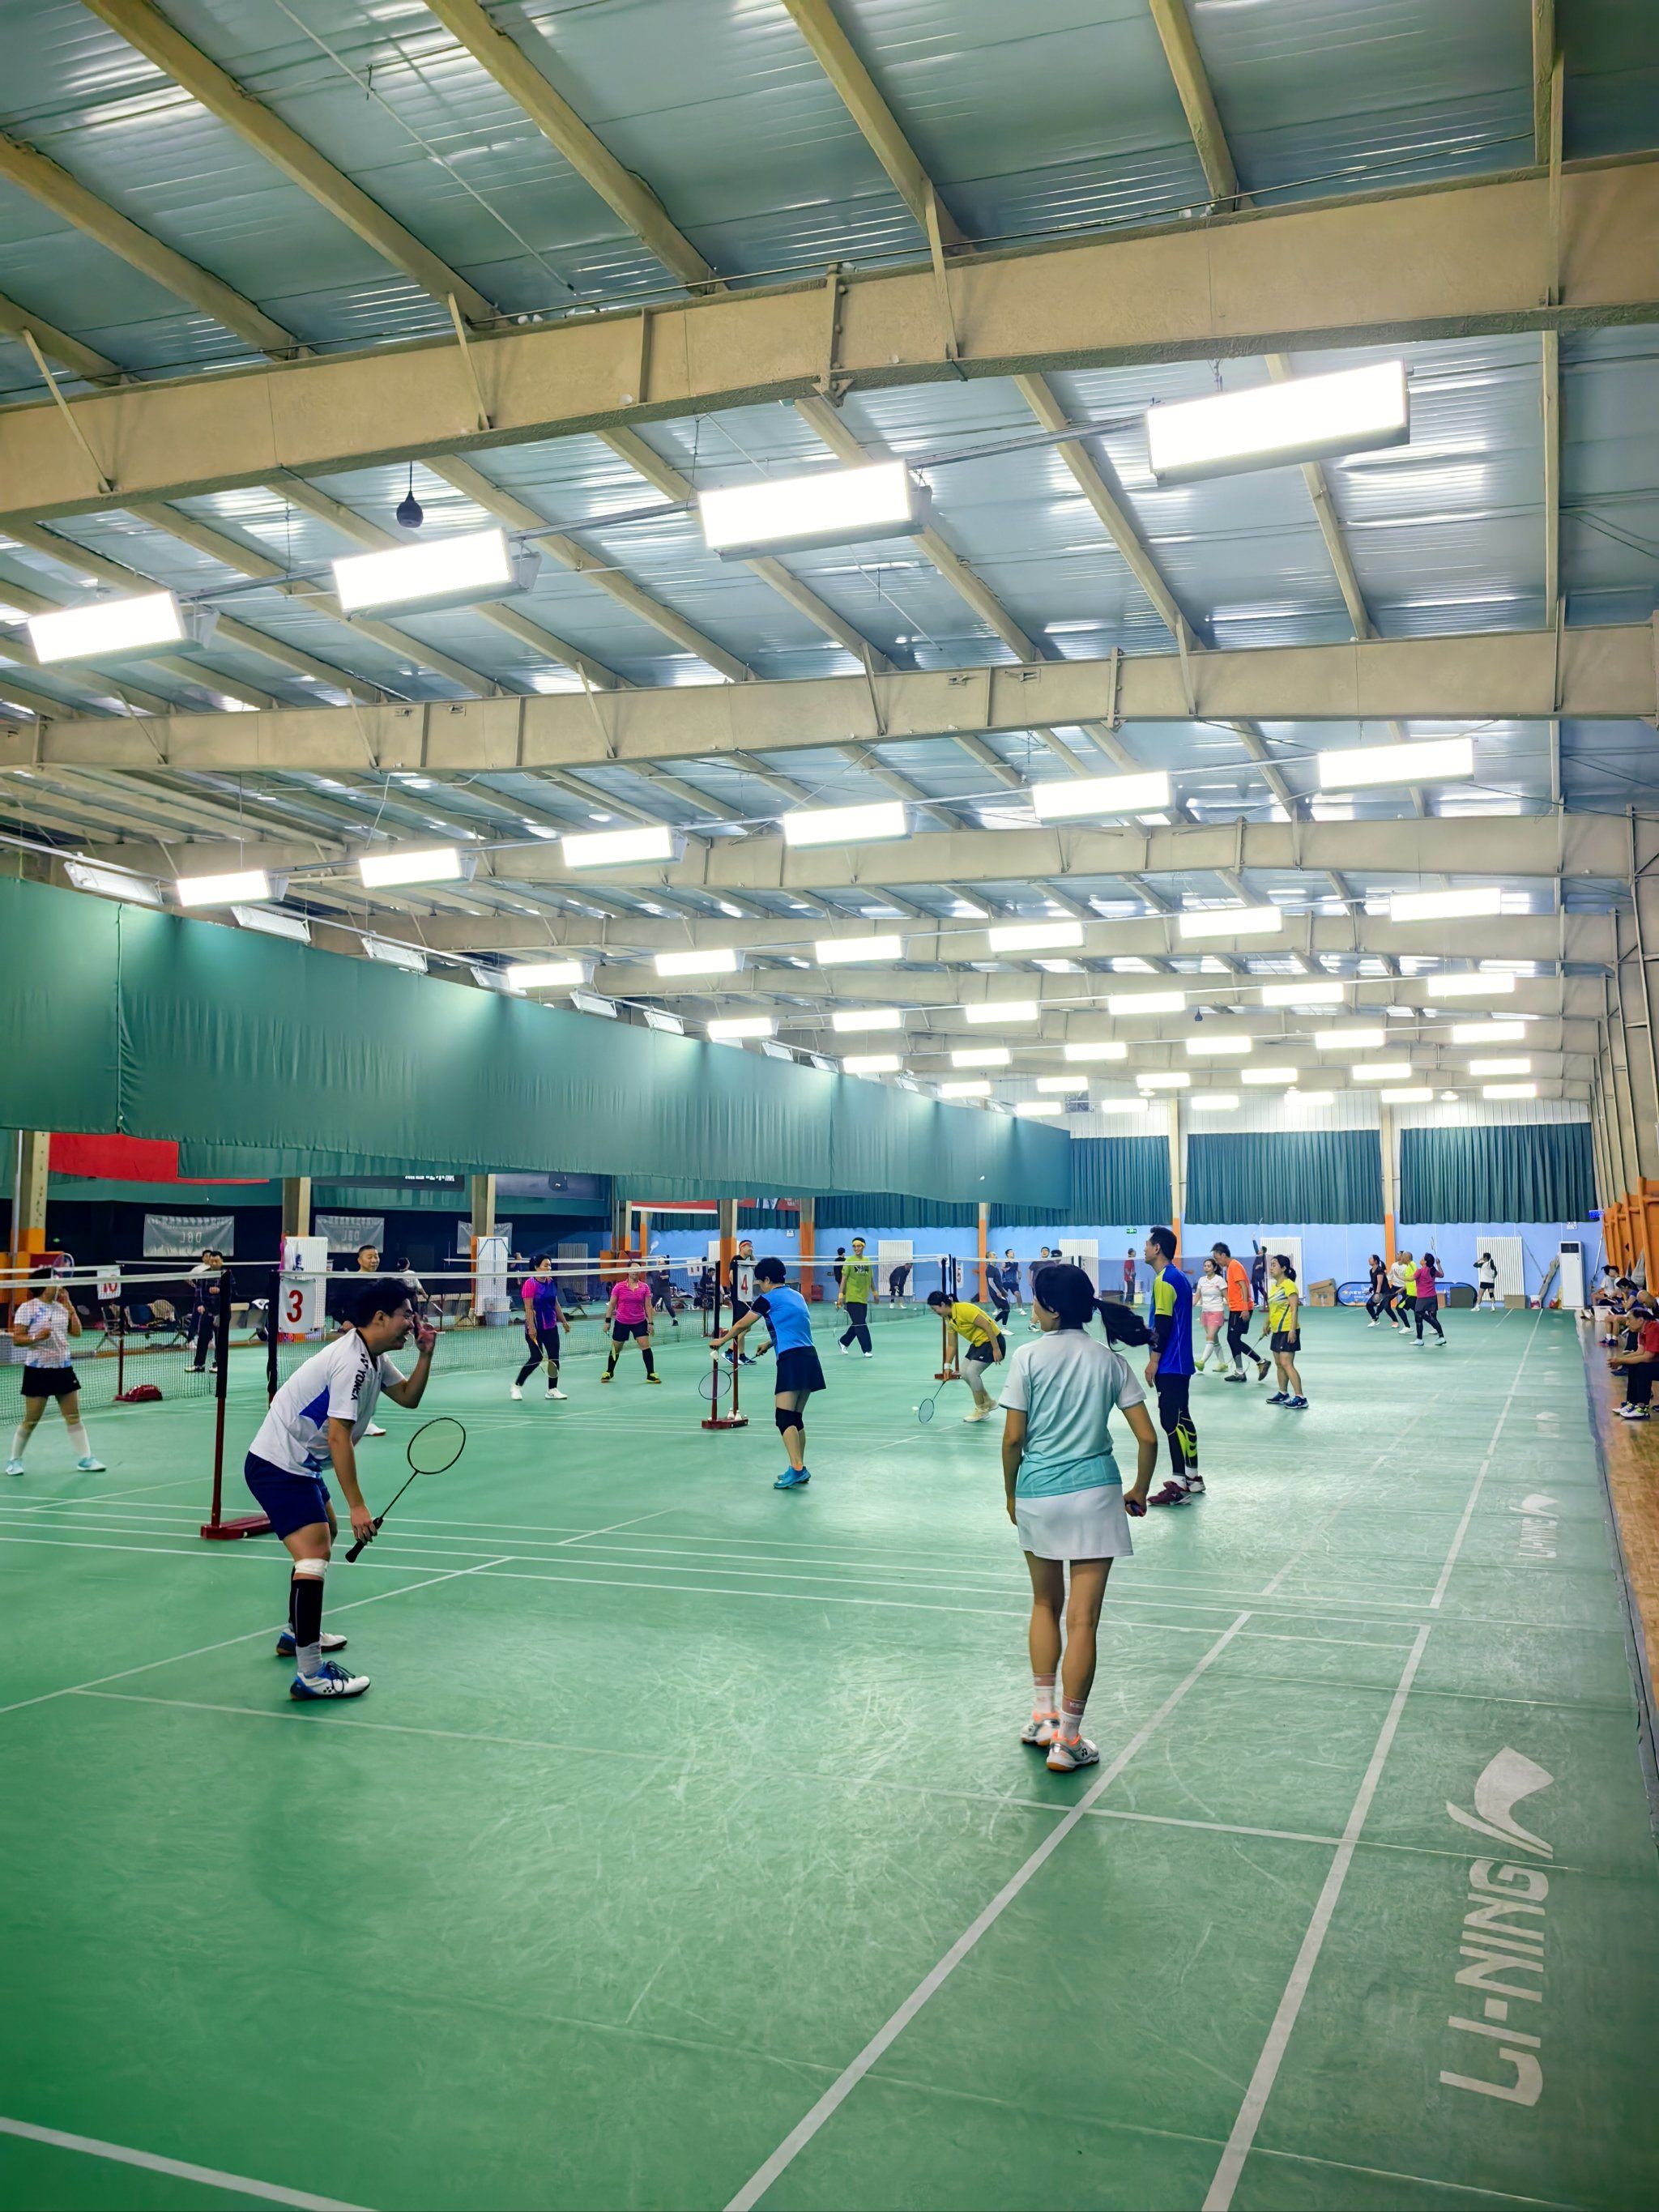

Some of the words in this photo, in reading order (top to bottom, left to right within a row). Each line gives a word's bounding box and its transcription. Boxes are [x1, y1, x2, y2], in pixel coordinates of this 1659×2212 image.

[740, 1274, 748, 1294] 4
[287, 1289, 303, 1323] 3
[1439, 1858, 1550, 2108] LI-NING
